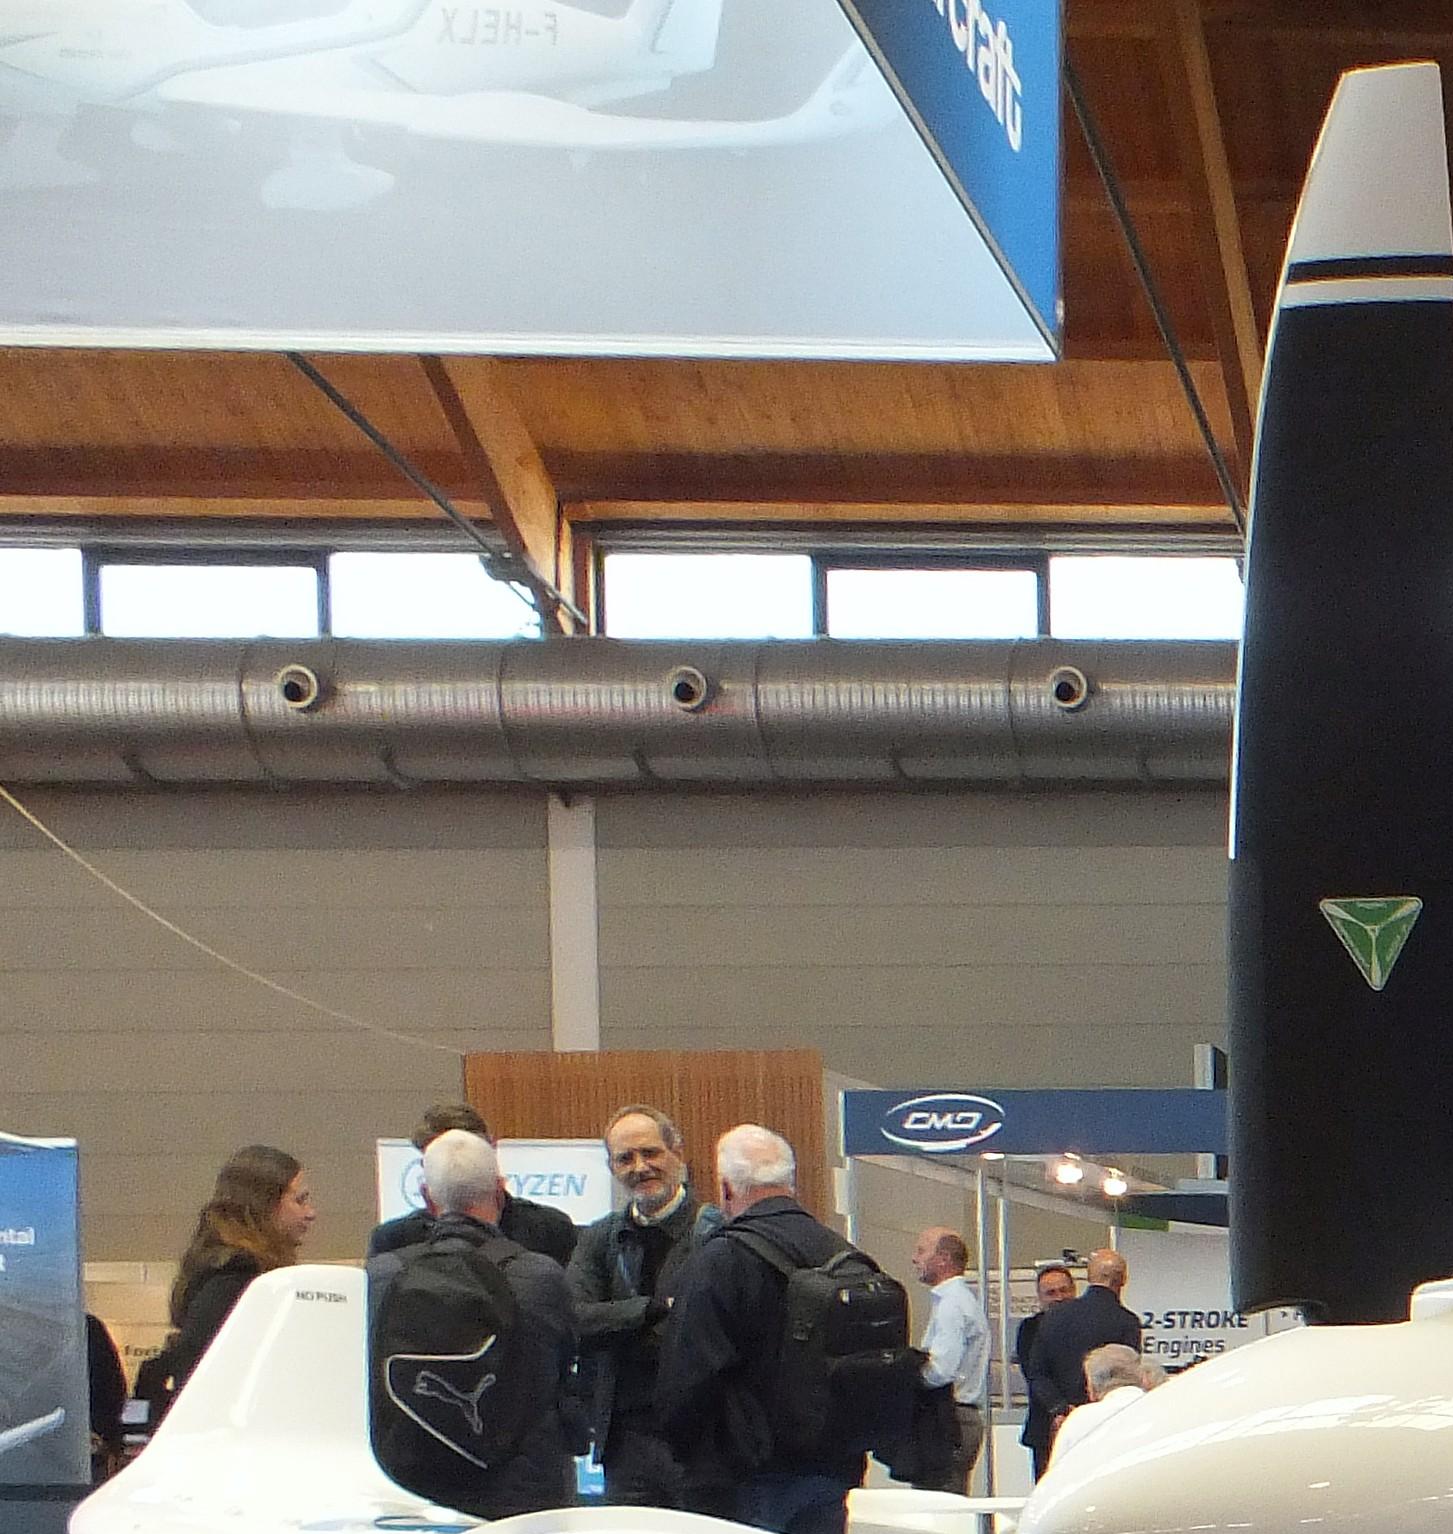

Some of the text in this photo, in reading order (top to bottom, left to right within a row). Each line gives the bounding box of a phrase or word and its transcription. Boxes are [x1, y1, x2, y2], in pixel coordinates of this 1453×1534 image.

[933, 0, 1021, 152] craft
[506, 1174, 588, 1197] YZEN
[1142, 1310, 1249, 1329] 2-STROKE
[1143, 1335, 1226, 1358] Engines
